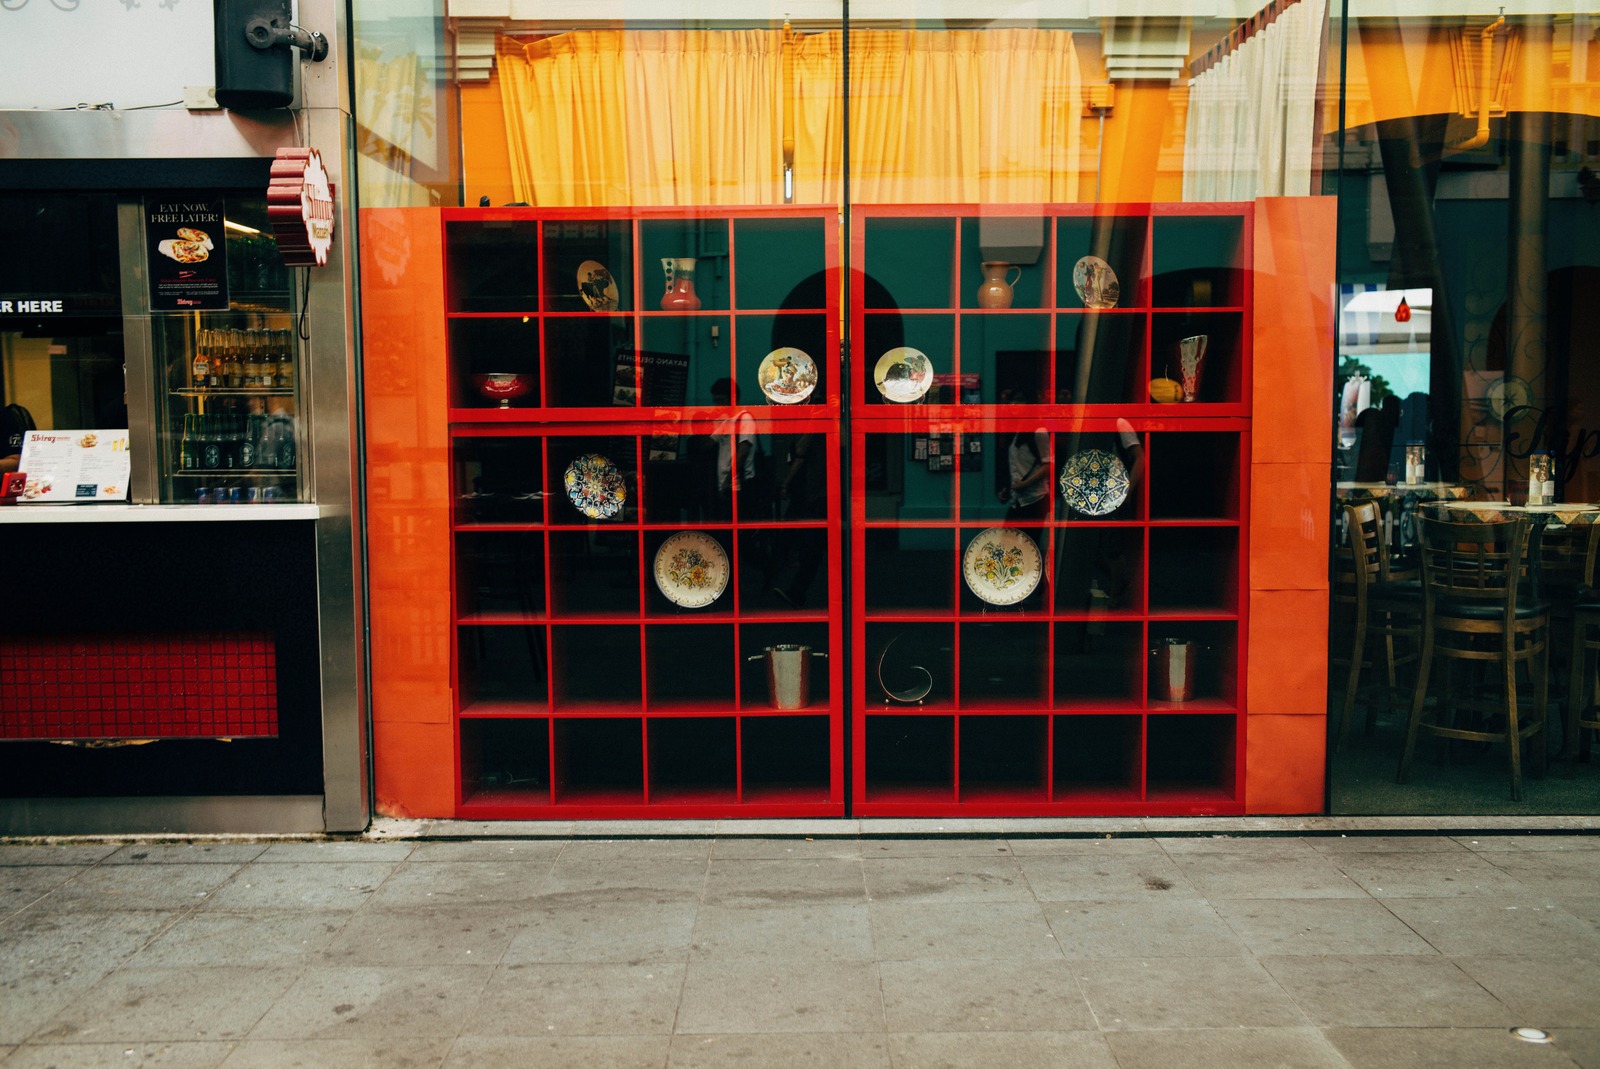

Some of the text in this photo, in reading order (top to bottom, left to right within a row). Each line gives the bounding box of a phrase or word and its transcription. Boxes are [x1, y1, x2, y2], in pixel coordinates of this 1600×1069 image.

[160, 203, 180, 213] EAT
[151, 213, 219, 223] FREE LATER!
[0, 301, 63, 313] R HERE
[31, 434, 56, 444] Shiraz
